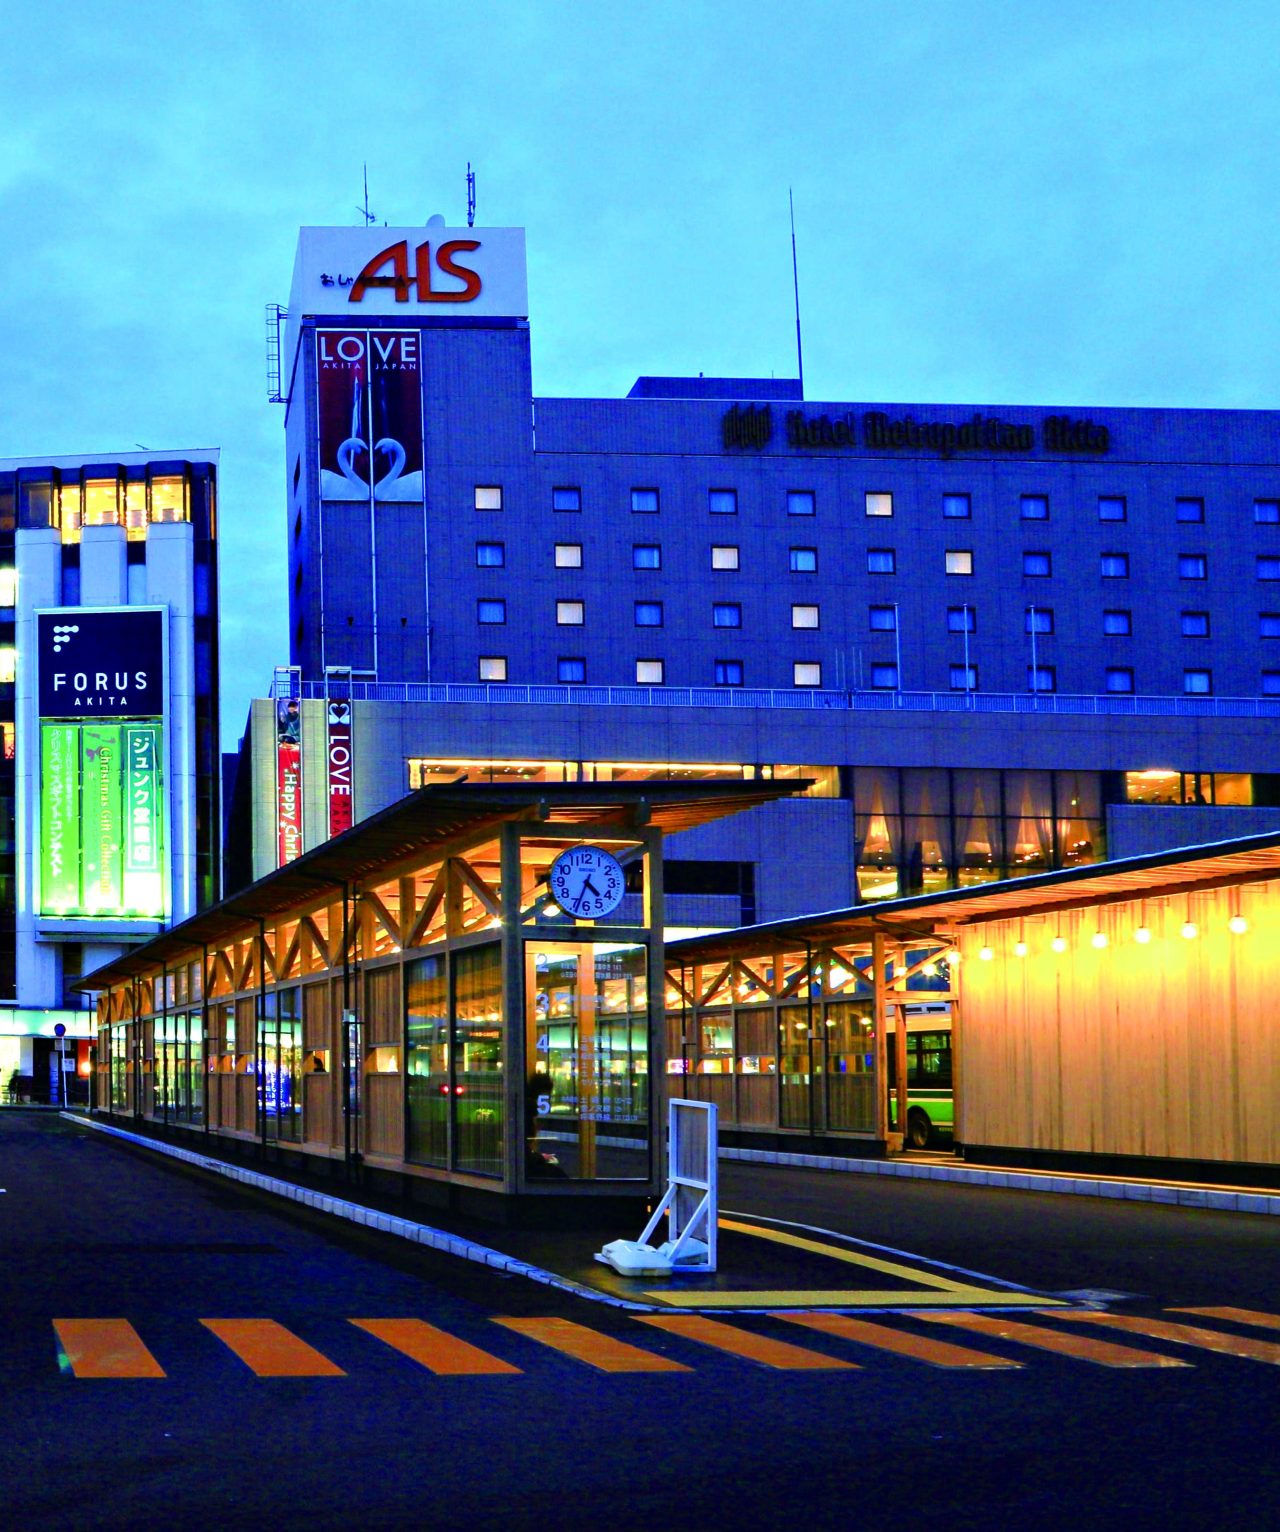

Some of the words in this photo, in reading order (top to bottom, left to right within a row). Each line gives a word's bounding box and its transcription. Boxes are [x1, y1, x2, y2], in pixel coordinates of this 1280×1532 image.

[321, 336, 416, 362] LOVE
[54, 672, 148, 691] FORUS
[74, 697, 128, 706] AKITA
[330, 735, 350, 796] LOVE
[281, 773, 298, 820] Happy
[284, 825, 299, 864] Chris
[570, 855, 579, 866] 11
[581, 853, 593, 865] 12
[597, 857, 601, 867] 1
[559, 864, 571, 875] 10
[604, 865, 612, 876] 2
[556, 876, 565, 887] 9
[607, 878, 616, 888] 3
[561, 888, 570, 898] 8
[604, 890, 612, 900] 4
[571, 897, 580, 908] 7
[582, 901, 591, 911] 6
[594, 899, 603, 909] 5
[537, 953, 549, 973] 2
[536, 993, 549, 1013] 3
[536, 1033, 549, 1053] 4
[536, 1094, 550, 1115] 5
